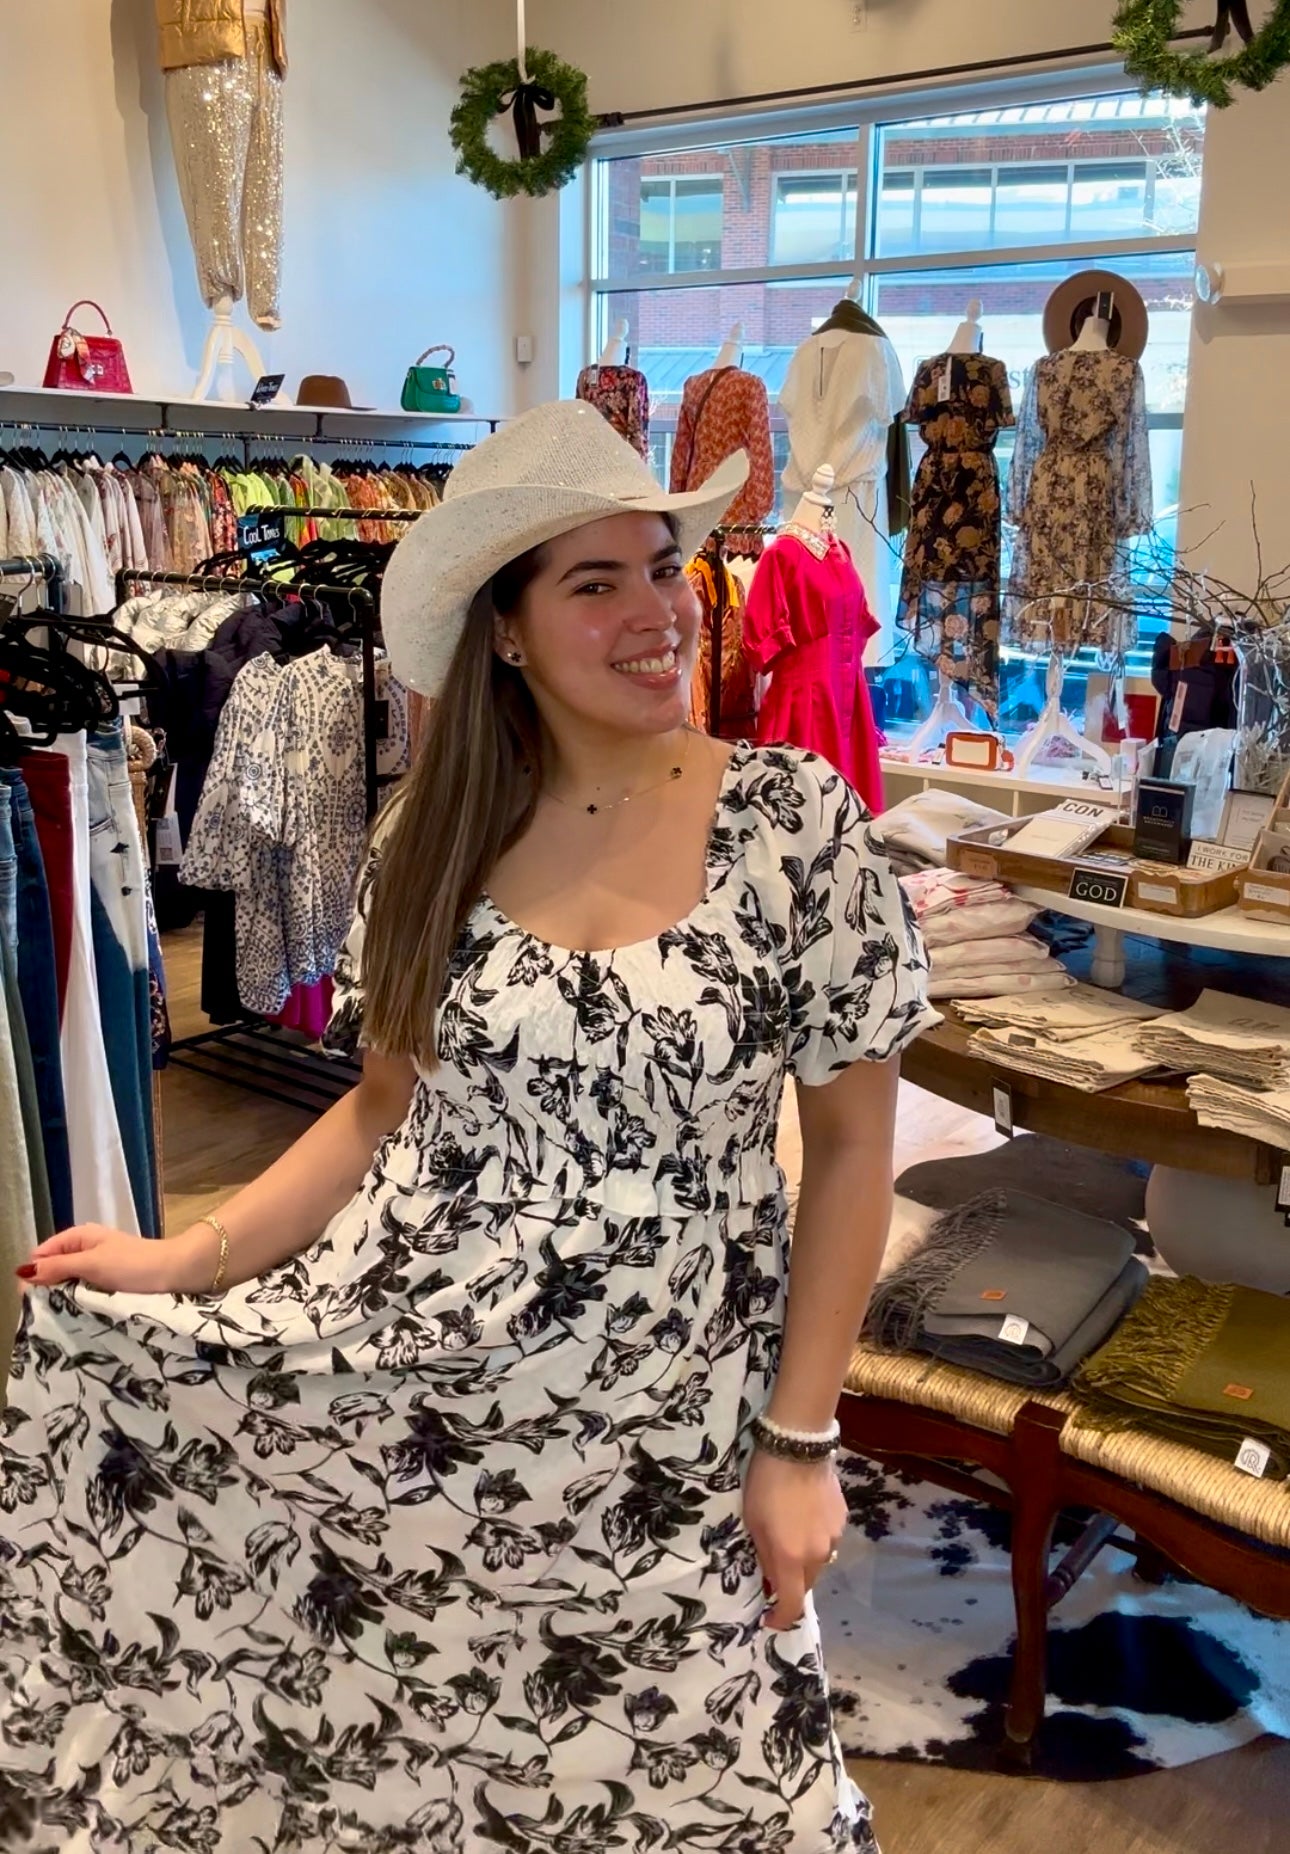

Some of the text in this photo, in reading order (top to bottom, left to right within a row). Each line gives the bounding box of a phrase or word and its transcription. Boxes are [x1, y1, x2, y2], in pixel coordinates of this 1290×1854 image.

[1063, 802, 1104, 818] CON
[1191, 854, 1214, 869] THE
[1230, 851, 1249, 861] FOR
[1075, 881, 1117, 902] GOD
